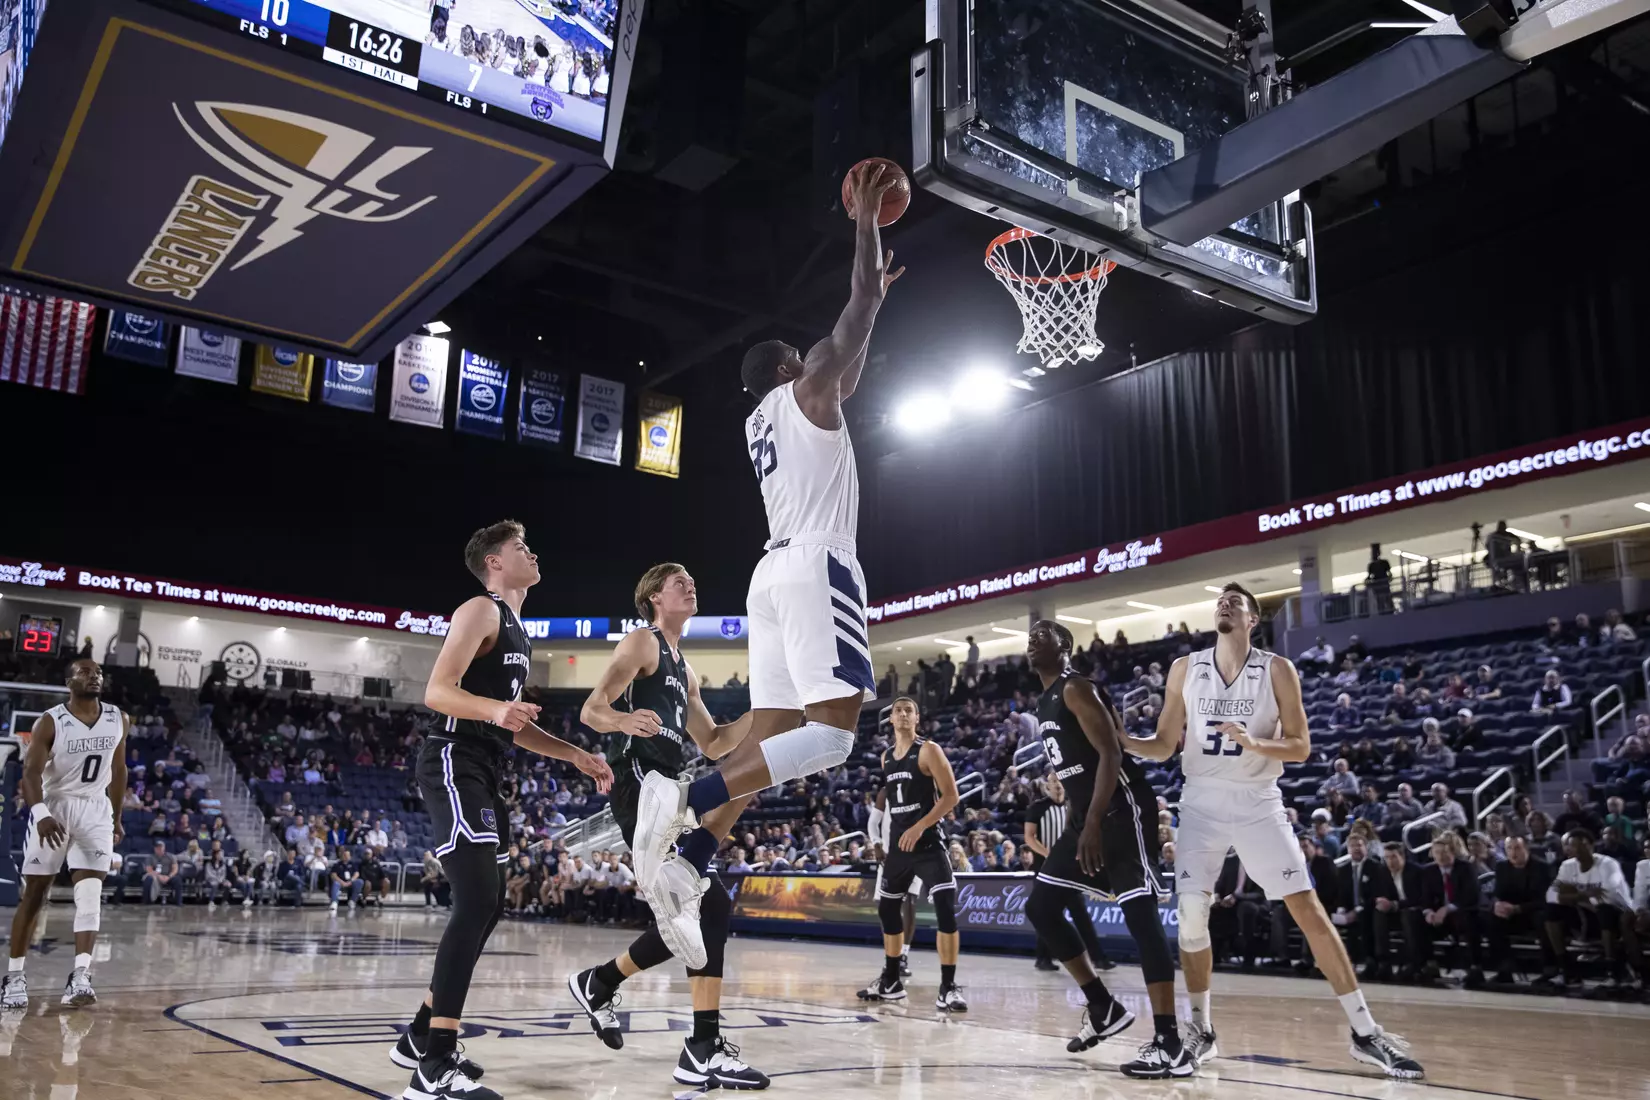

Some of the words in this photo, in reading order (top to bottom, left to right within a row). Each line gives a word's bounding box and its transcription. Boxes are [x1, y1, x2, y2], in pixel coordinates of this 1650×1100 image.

[260, 0, 290, 27] 10
[240, 19, 269, 39] FLS
[280, 33, 288, 46] 1
[349, 22, 403, 64] 16:26
[340, 55, 364, 70] 1ST
[373, 66, 407, 85] HALF
[468, 63, 483, 93] 7
[446, 90, 472, 109] FLS
[481, 103, 488, 115] 1
[127, 174, 271, 300] LANCERS
[466, 364, 502, 378] WOMEN'S
[472, 354, 500, 369] 2017
[532, 370, 559, 383] 2017
[324, 380, 373, 396] CHAMPIONS
[589, 383, 615, 396] 2017
[460, 410, 503, 424] CHAMPIONS
[750, 422, 778, 484] 35
[1258, 508, 1301, 532] Book
[1303, 502, 1335, 521] Tee
[1337, 489, 1392, 514] Times
[1395, 480, 1415, 501] at
[1416, 428, 1650, 496] www.goosecreekgc.co
[1093, 548, 1128, 573] Goose
[1125, 537, 1162, 559] Creek
[1108, 561, 1128, 573] GOLF
[1127, 556, 1148, 569] CLUB
[21, 561, 66, 581] Creek
[21, 576, 46, 587] CLUB
[884, 597, 913, 616] Inland
[914, 588, 957, 609] Empire's
[958, 584, 979, 600] Top
[980, 574, 1012, 594] Rated
[1013, 567, 1039, 587] Golf
[1039, 557, 1086, 581] Course!
[78, 571, 120, 590] Book
[124, 577, 153, 593] Tee
[155, 581, 201, 601] Times
[204, 588, 219, 602] at
[221, 590, 386, 624] www.goosecreekgc.com
[394, 610, 429, 630] Goose
[410, 625, 428, 635] GOLF
[575, 619, 591, 638] 10
[24, 630, 52, 652] 23
[157, 645, 202, 657] EQUIPPED
[158, 653, 169, 661] TO
[171, 654, 199, 663] SERVE
[265, 658, 308, 668] GLOBALLY
[1198, 697, 1254, 716] LANCERS
[67, 736, 116, 754] LANCERS
[81, 754, 102, 783] 0
[896, 783, 903, 803] 1
[954, 884, 1001, 917] Goose
[968, 911, 995, 925] GOLF
[996, 912, 1025, 926] CLUB
